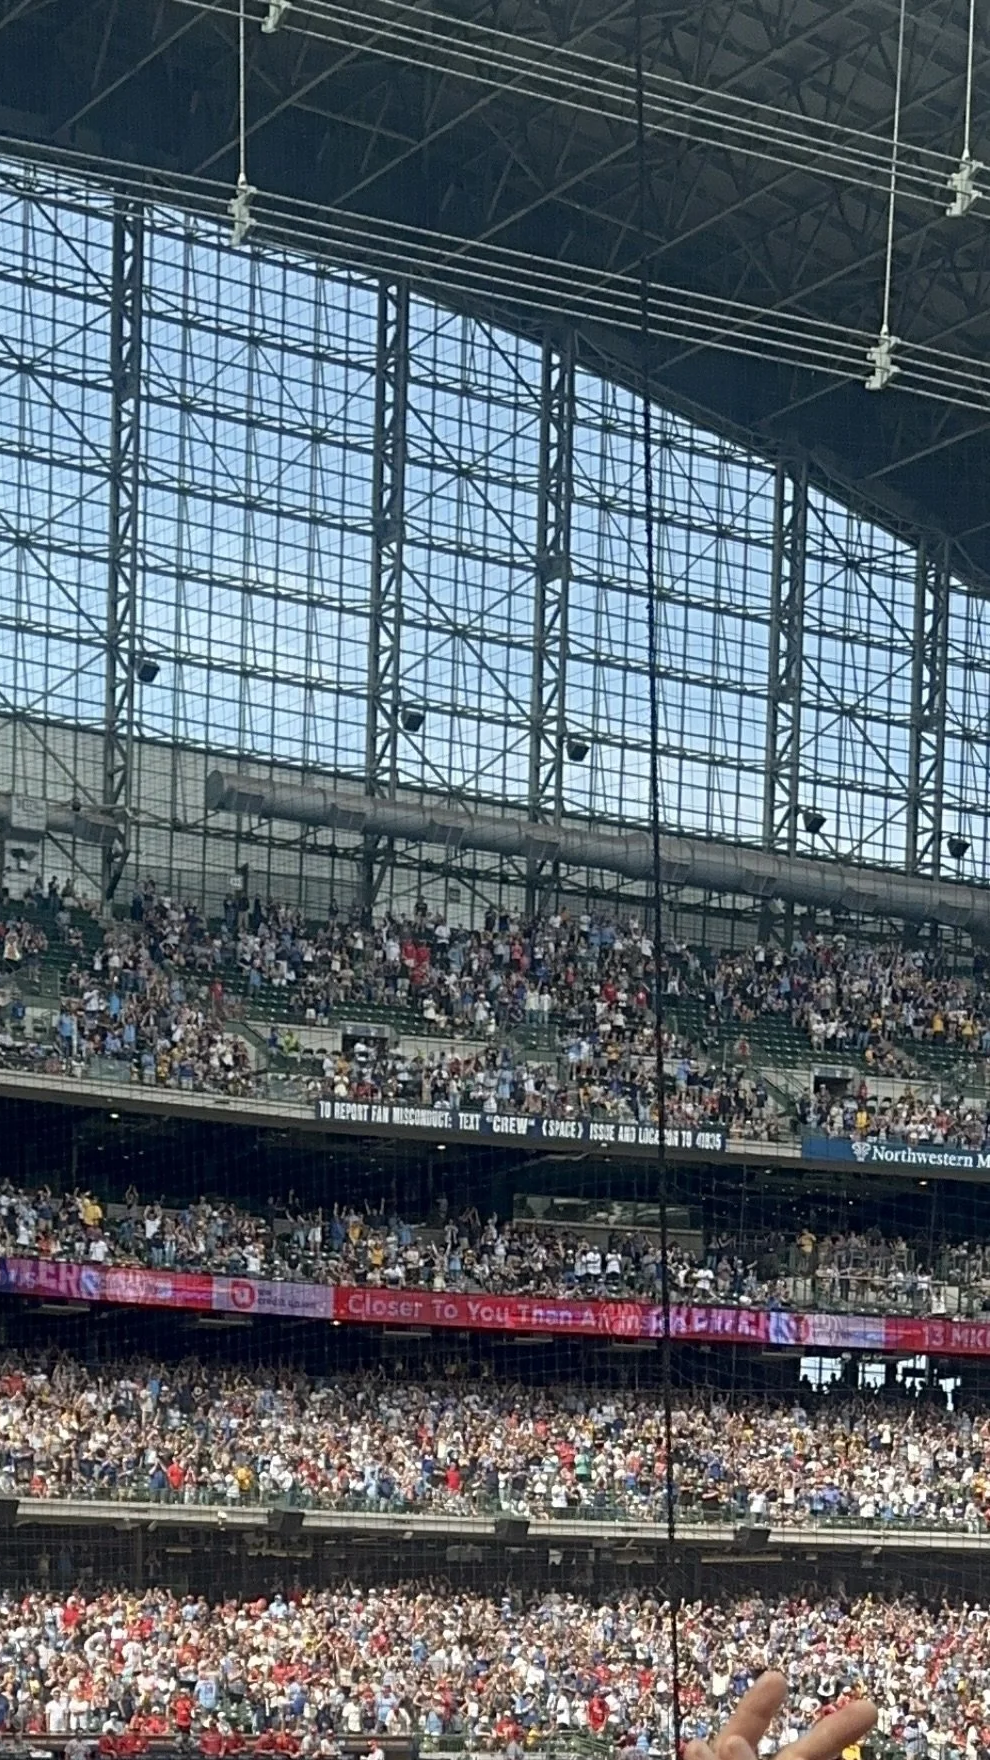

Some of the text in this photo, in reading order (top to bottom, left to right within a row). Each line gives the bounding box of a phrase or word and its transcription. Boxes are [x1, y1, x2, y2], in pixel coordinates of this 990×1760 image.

[319, 1100, 331, 1119] TO
[334, 1102, 370, 1122] REPORT
[371, 1105, 390, 1124] FAN
[392, 1107, 453, 1129] MISCONDUCT:
[458, 1113, 481, 1131] TEXT
[589, 1123, 616, 1142] ISSUE
[618, 1126, 636, 1144] AND
[681, 1131, 692, 1148] TO
[872, 1145, 974, 1168] Northwestern
[431, 1300, 458, 1320] To
[467, 1302, 510, 1324] You
[921, 1325, 945, 1347] 13
